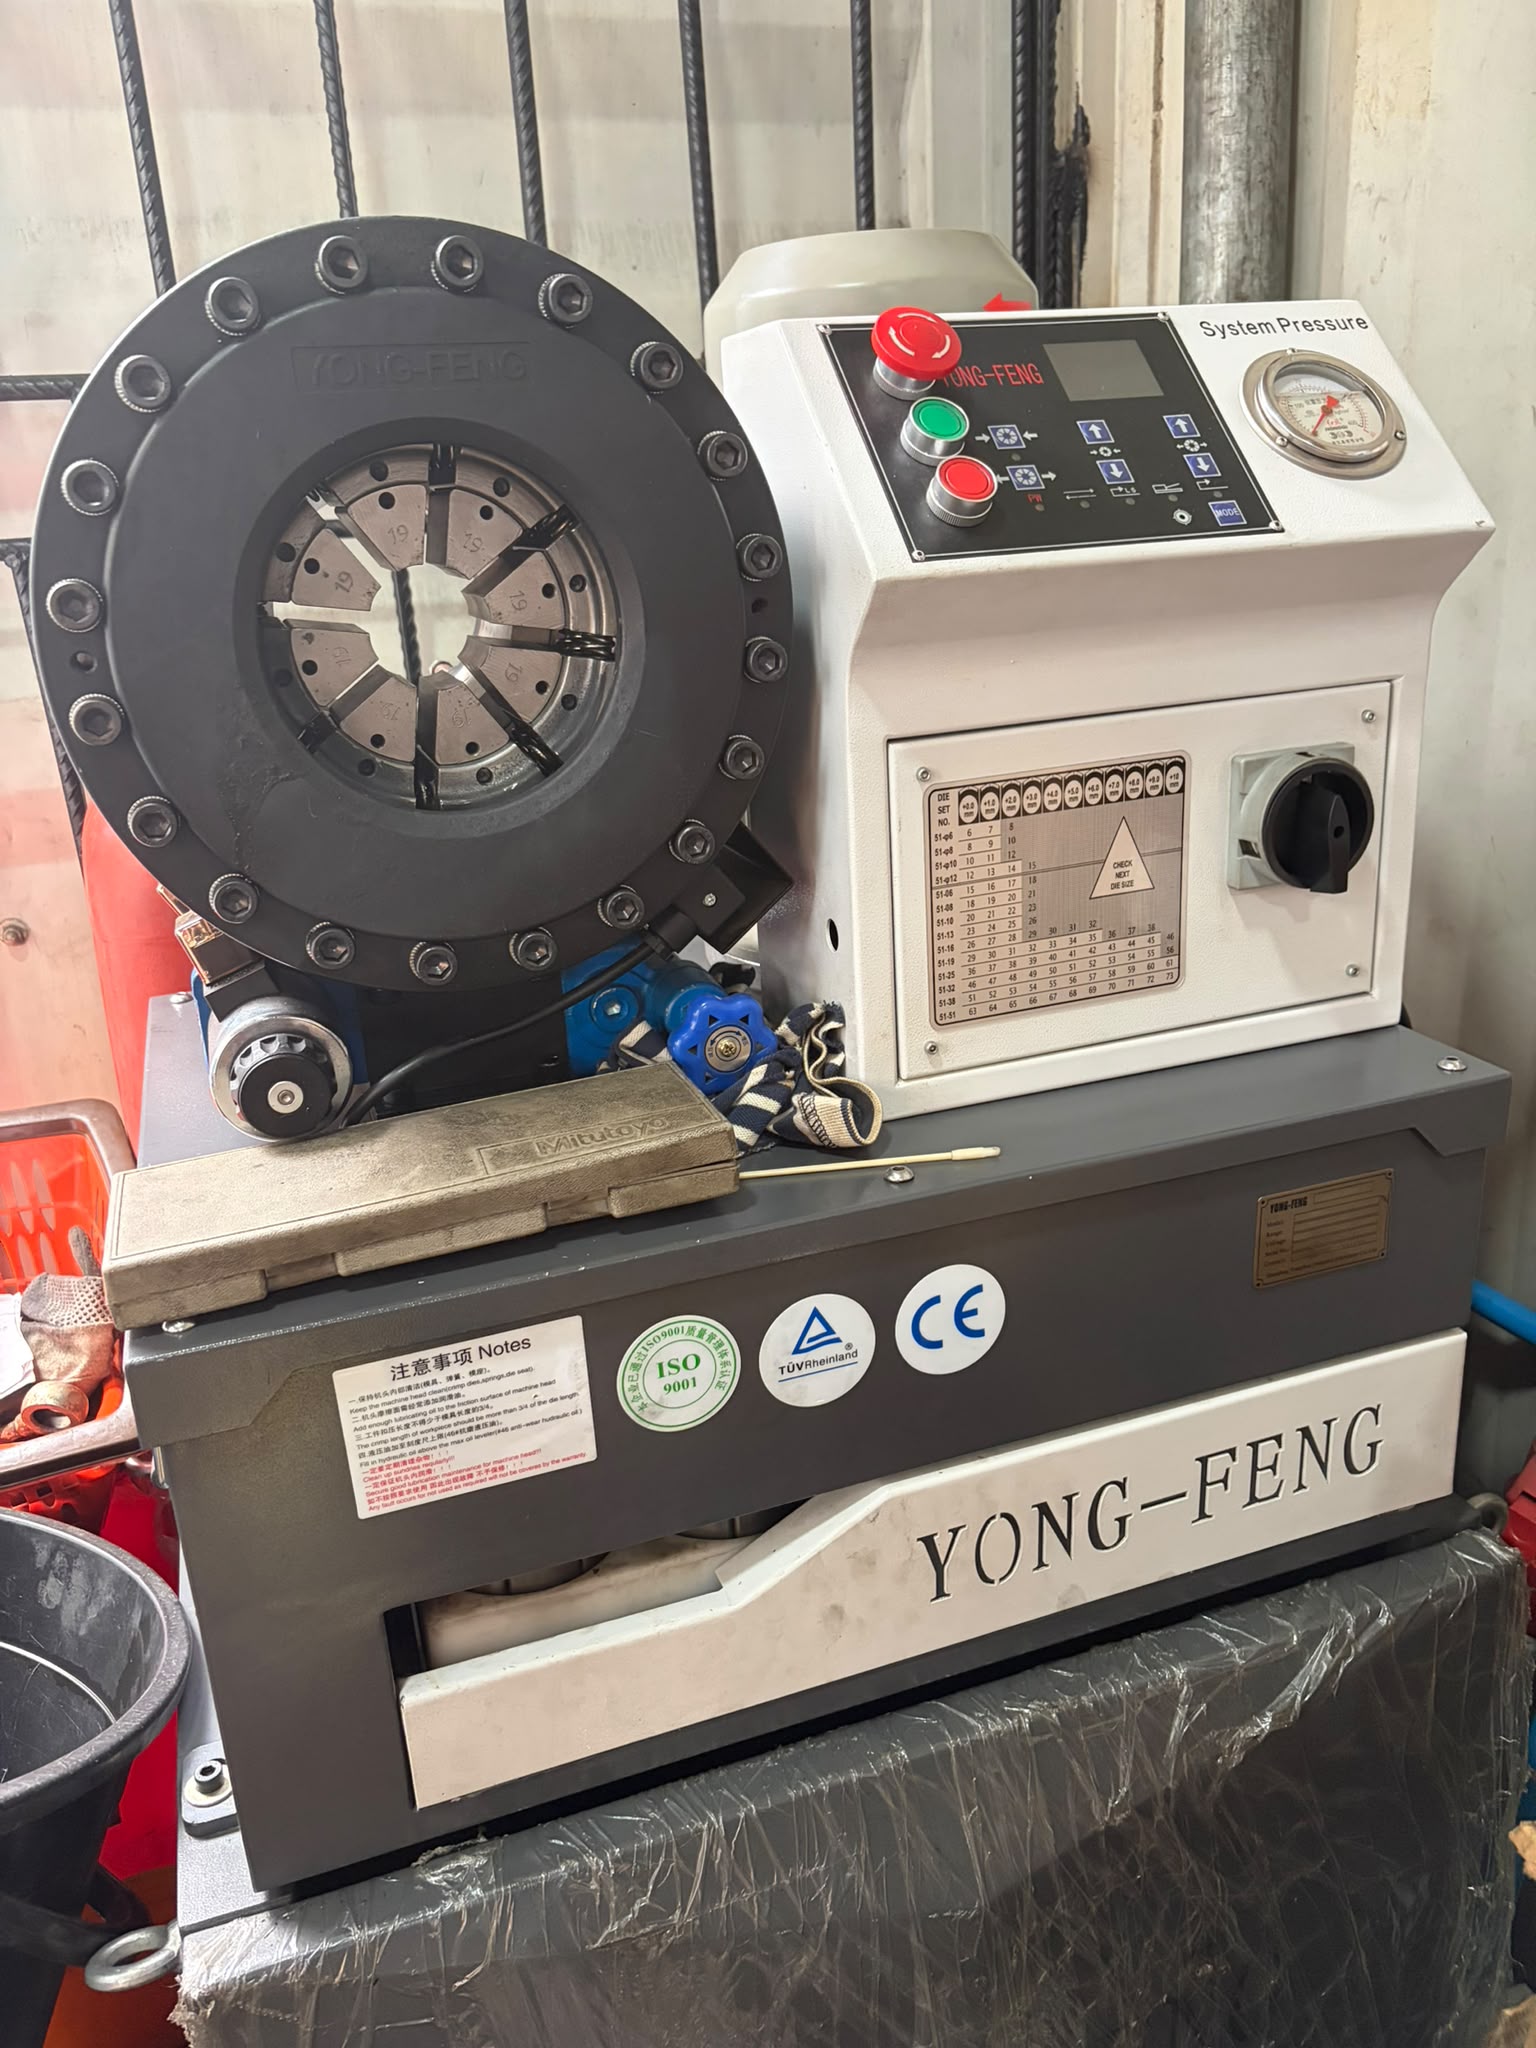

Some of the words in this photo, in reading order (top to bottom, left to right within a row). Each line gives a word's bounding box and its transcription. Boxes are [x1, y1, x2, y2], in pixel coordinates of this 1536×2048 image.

[1199, 320, 1277, 339] System
[1276, 316, 1369, 333] Pressure
[311, 350, 529, 386] YONG-FENG
[1215, 507, 1240, 518] MODE
[388, 524, 409, 545] 19
[335, 571, 354, 593] 19
[509, 590, 528, 611] 19
[1108, 781, 1119, 789] +7.0
[937, 792, 949, 801] DIE
[937, 804, 950, 814] SET
[937, 817, 950, 826] NO.
[1113, 859, 1132, 869] CHECK
[1115, 870, 1129, 879] NEXT
[966, 885, 974, 893] 15
[987, 882, 995, 890] 16
[1008, 879, 1015, 887] 17
[1028, 875, 1036, 884] 18
[1110, 881, 1120, 890] DIE
[1121, 879, 1134, 888] SIZE
[967, 899, 974, 907] 18
[988, 896, 995, 904] 19
[1008, 893, 1016, 901] 20
[1028, 889, 1036, 898] 21
[966, 913, 974, 921] 20
[987, 910, 994, 918] 21
[1008, 906, 1015, 914] 22
[1028, 902, 1036, 912] 23
[967, 926, 974, 935] 23
[987, 923, 995, 931] 24
[1008, 920, 1015, 928] 25
[1028, 916, 1036, 925] 26
[967, 940, 975, 948] 26
[987, 936, 995, 945] 27
[1008, 933, 1016, 941] 28
[1028, 929, 1036, 938] 29
[1048, 926, 1056, 935] 30
[1068, 923, 1076, 932] 31
[1088, 919, 1096, 928] 32
[967, 954, 975, 962] 29
[988, 950, 996, 958] 30
[1008, 947, 1015, 955] 31
[1029, 943, 1036, 951] 32
[1049, 940, 1056, 948] 33
[1069, 936, 1076, 944] 34
[1088, 933, 1096, 941] 35
[1108, 930, 1116, 938] 36
[1128, 926, 1135, 935] 37
[1147, 923, 1155, 932] 38
[968, 967, 975, 975] 36
[988, 963, 996, 971] 37
[1008, 960, 1016, 968] 38
[1029, 956, 1036, 964] 39
[1166, 932, 1174, 941] 46
[968, 1007, 976, 1015] 63
[1009, 1000, 1016, 1008] 65
[1029, 996, 1037, 1004] 66
[1049, 992, 1056, 1000] 67
[1068, 989, 1076, 997] 68
[1088, 985, 1096, 993] 69
[1128, 978, 1134, 986] 71
[1166, 971, 1173, 979] 73
[536, 1117, 669, 1156] Mitutoyo
[910, 1284, 986, 1350] CE
[390, 1347, 473, 1382] 注意事项
[478, 1337, 531, 1360] Notes
[656, 1353, 701, 1379] ISO
[663, 1377, 697, 1395] 9001
[349, 1406, 367, 1415] Keep
[381, 1396, 407, 1406] machine
[409, 1392, 426, 1400] head
[368, 1418, 392, 1429] enough
[394, 1410, 427, 1423] lubricating
[457, 1398, 478, 1407] friction
[480, 1392, 502, 1401] surface
[512, 1383, 538, 1394] machine
[540, 1379, 555, 1387] head
[390, 1433, 410, 1442] length
[420, 1423, 451, 1435] workpiece
[453, 1417, 474, 1426] should
[485, 1410, 501, 1418] more
[503, 1406, 516, 1414] than
[417, 1444, 436, 1453] above
[916, 1403, 1385, 1605] YONG-FENG
